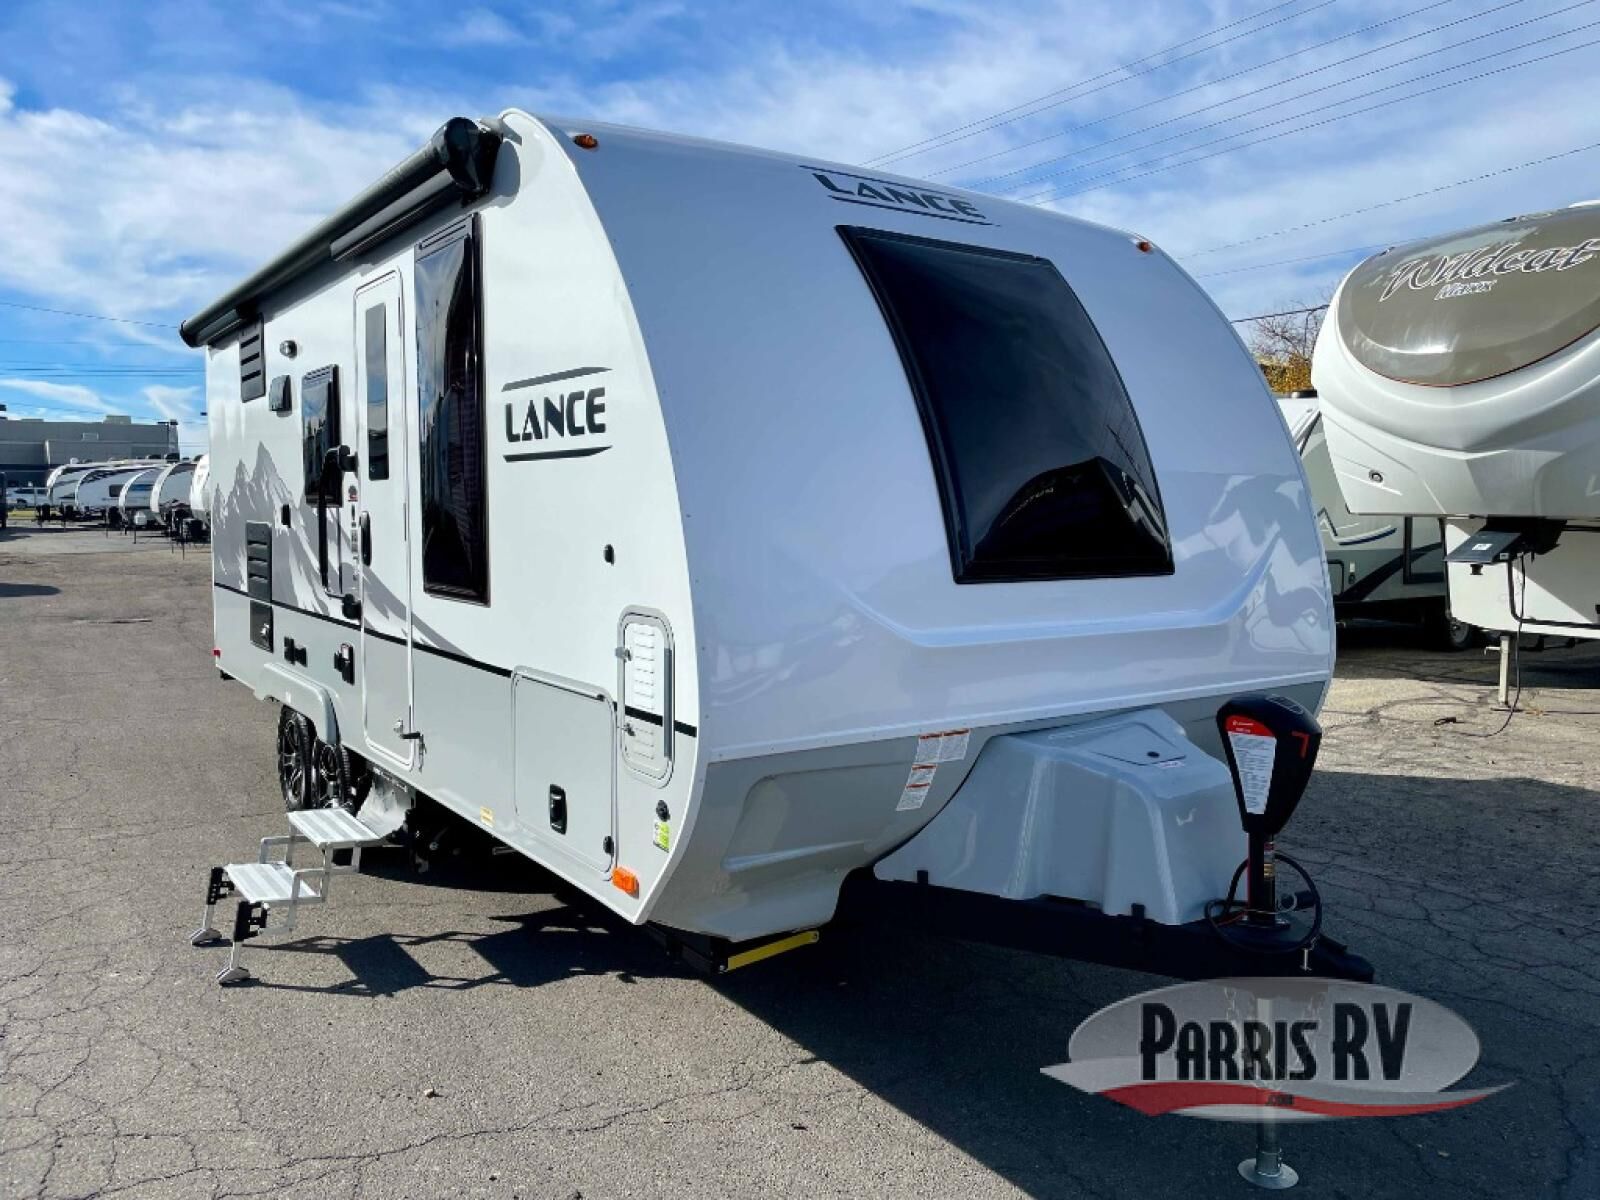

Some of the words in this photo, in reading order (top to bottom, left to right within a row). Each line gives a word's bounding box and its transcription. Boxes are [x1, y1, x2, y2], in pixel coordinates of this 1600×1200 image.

[812, 173, 986, 219] LANCE
[1379, 239, 1600, 302] Wildcat
[505, 387, 606, 443] LANCE
